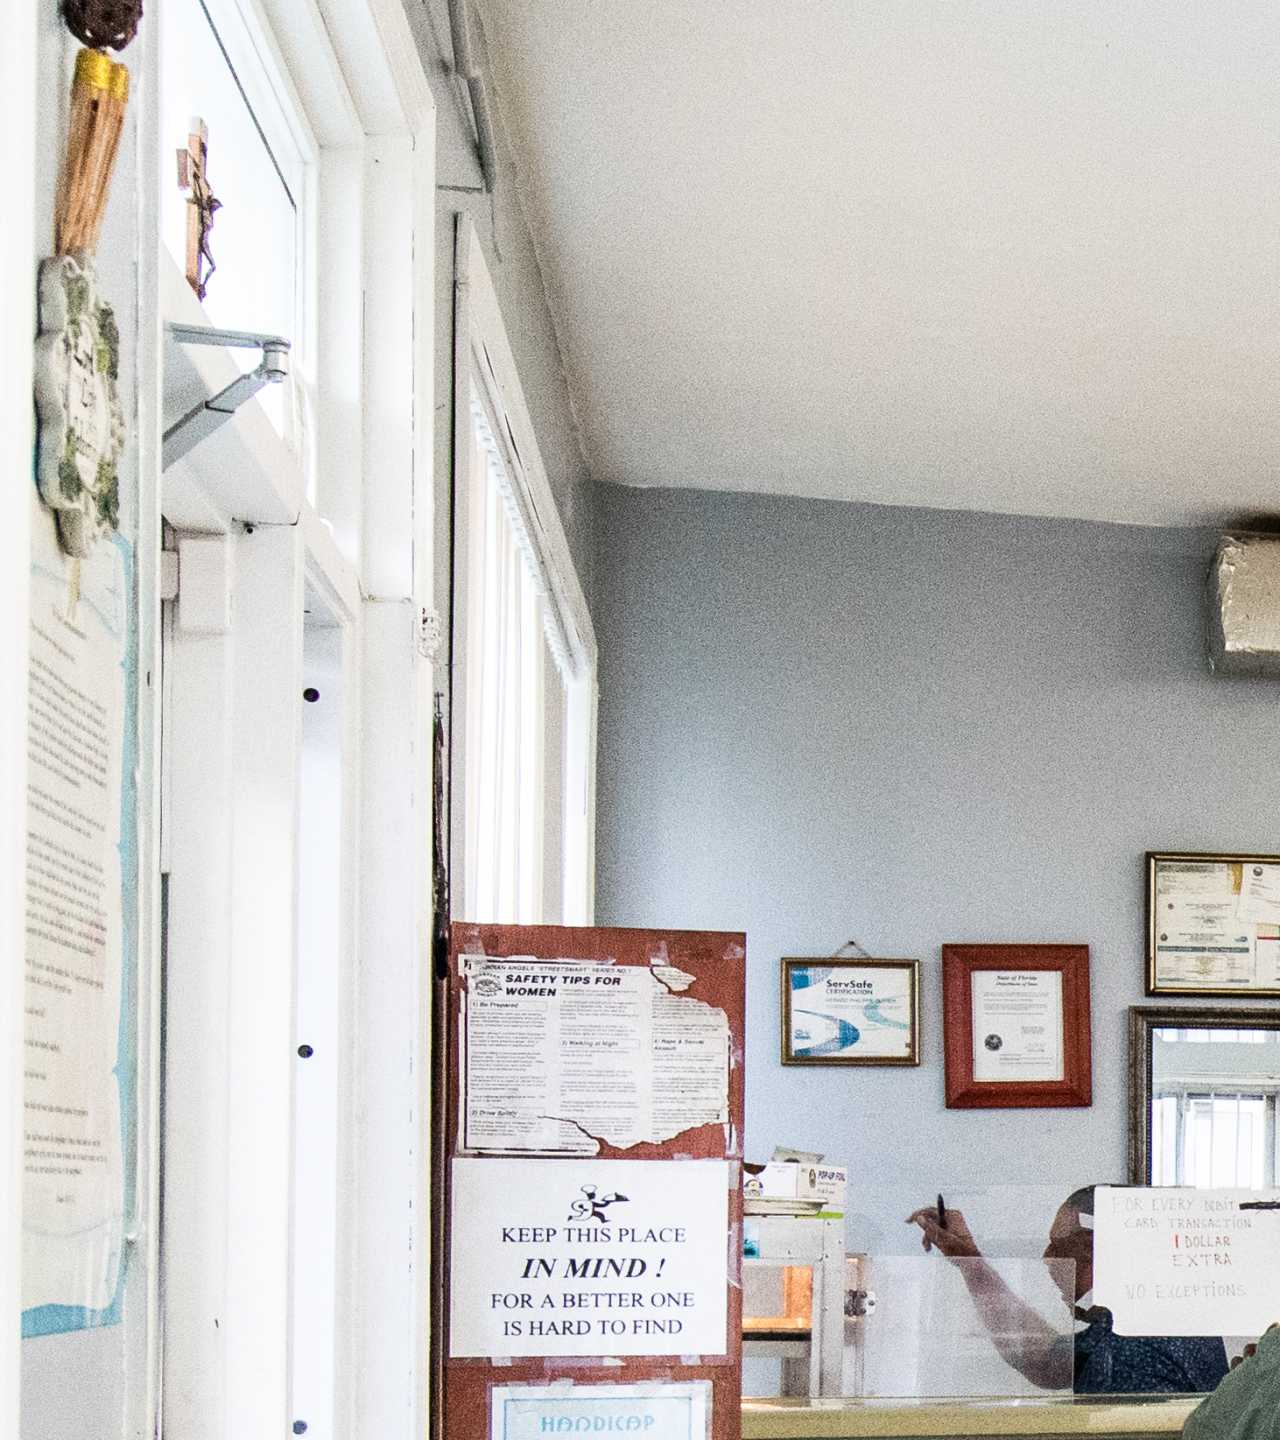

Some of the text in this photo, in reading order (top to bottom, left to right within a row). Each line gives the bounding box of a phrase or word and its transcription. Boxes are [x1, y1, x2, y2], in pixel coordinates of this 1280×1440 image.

[505, 974, 557, 984] SAFETY
[561, 975, 590, 985] TIPS
[595, 976, 621, 986] FOR
[826, 979, 872, 988] ServSafe
[505, 987, 557, 996] WOMEN
[1112, 1197, 1145, 1213] FOR
[1152, 1198, 1193, 1213] EVERY
[502, 1227, 686, 1243] KEEP THIS PLACE
[1185, 1235, 1231, 1248] DOLLAR
[1173, 1252, 1232, 1267] EXTRA
[520, 1258, 558, 1278] IN
[563, 1258, 647, 1278] MIND
[491, 1292, 695, 1309] FOR A BETTER ONE
[503, 1319, 683, 1336] IS HARD TO FIND
[541, 1415, 655, 1433] HANDICAP
